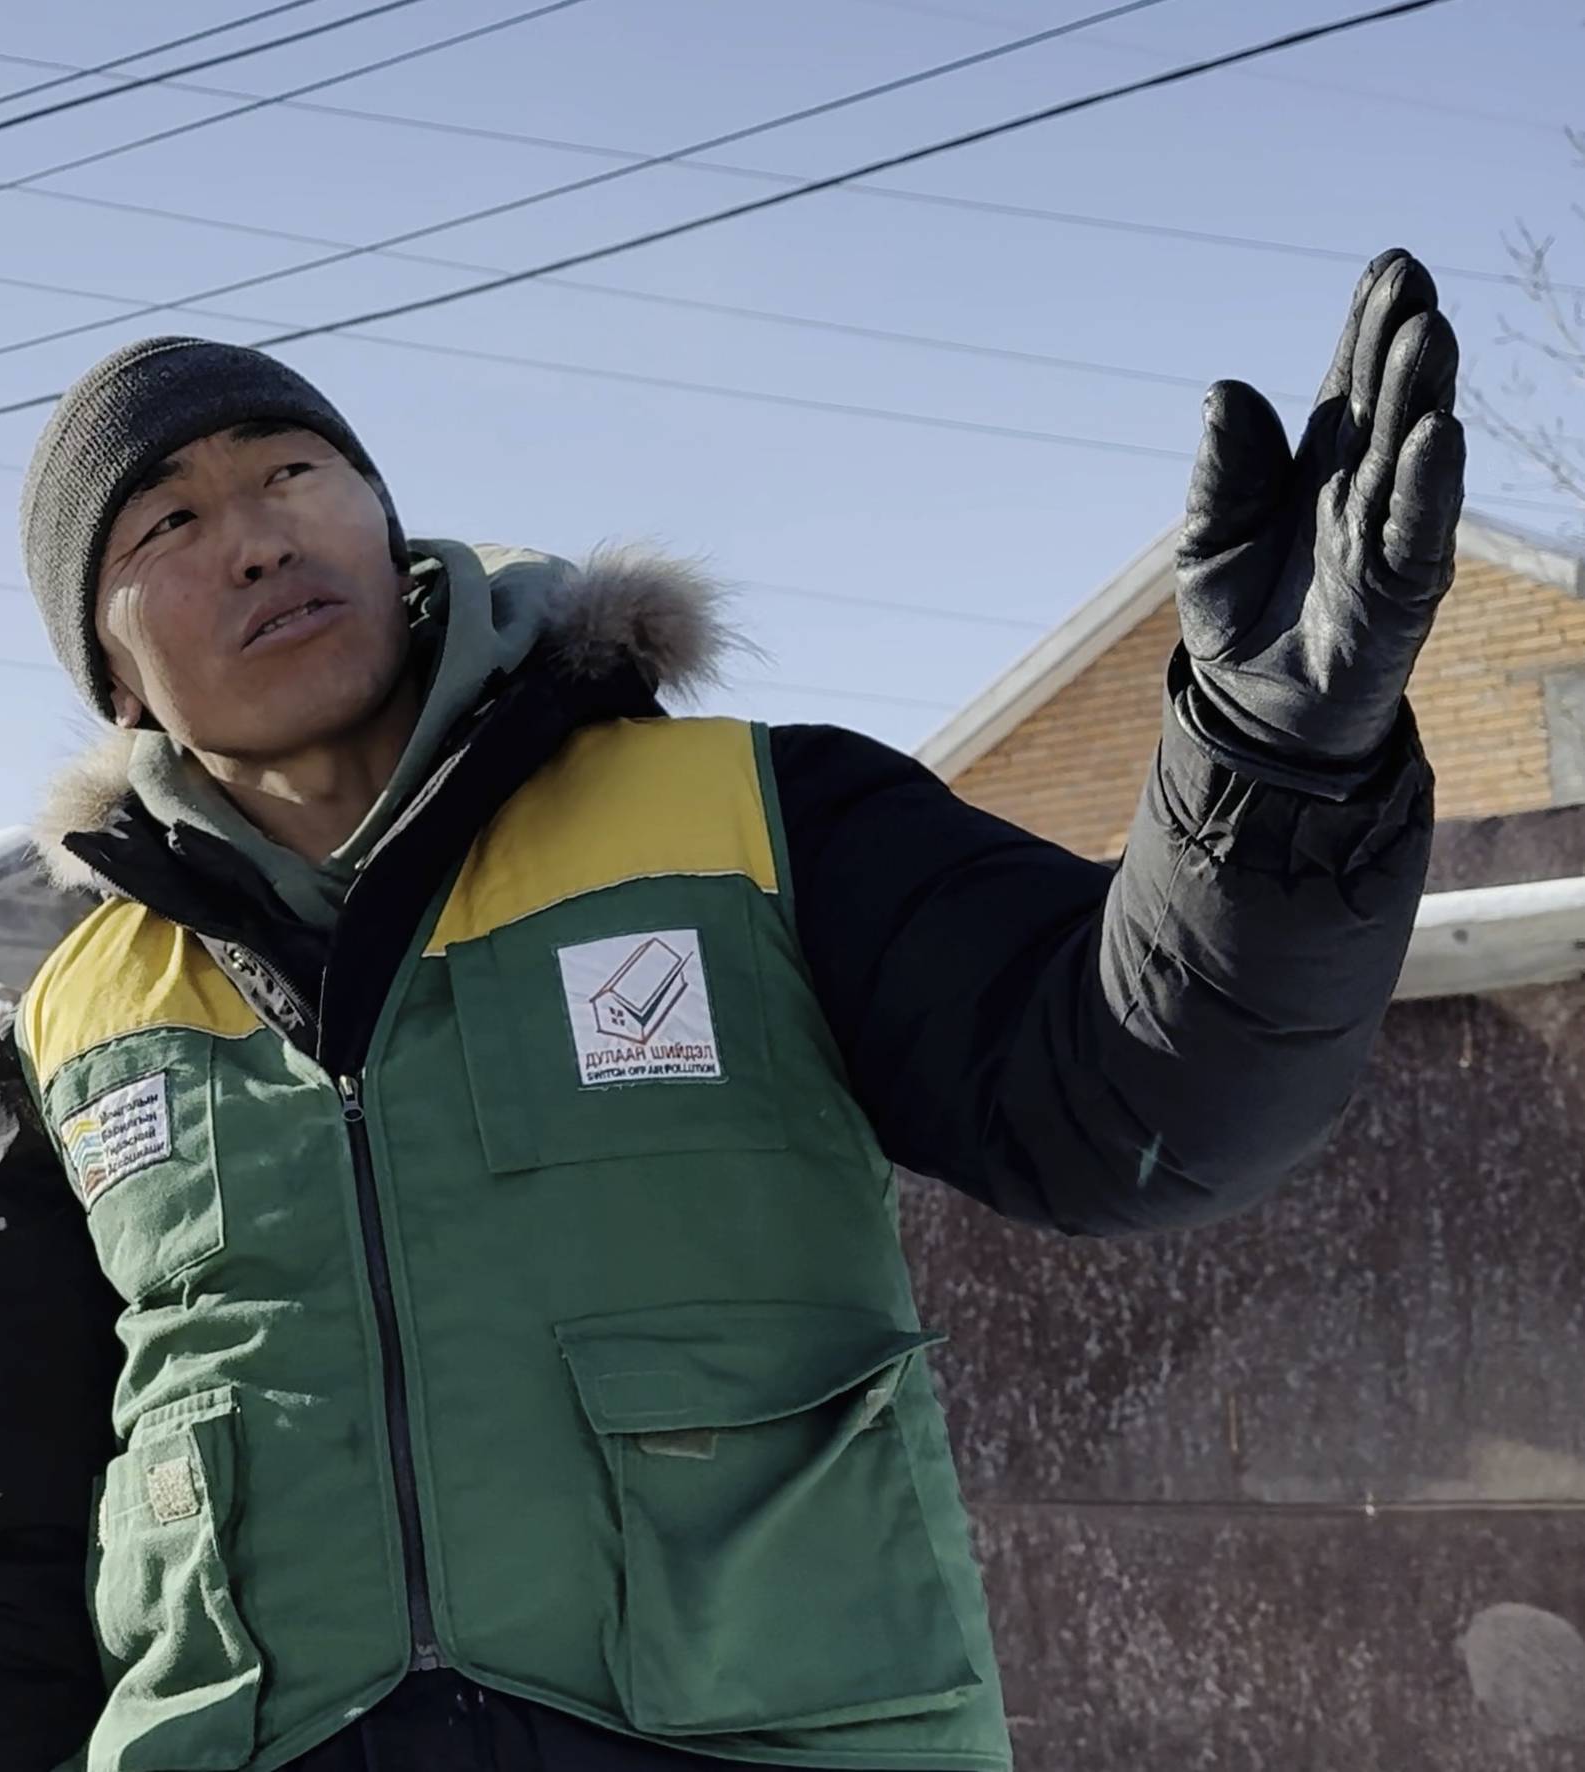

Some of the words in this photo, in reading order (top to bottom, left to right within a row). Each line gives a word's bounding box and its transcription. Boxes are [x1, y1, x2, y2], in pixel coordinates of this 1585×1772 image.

[586, 1047, 646, 1068] ДУЛААН
[650, 1042, 713, 1061] ШИЙДЭЛ
[587, 1067, 626, 1081] SWITCH
[628, 1065, 646, 1075] OFF
[648, 1064, 664, 1074] AIR
[664, 1063, 716, 1074] POLLUTION
